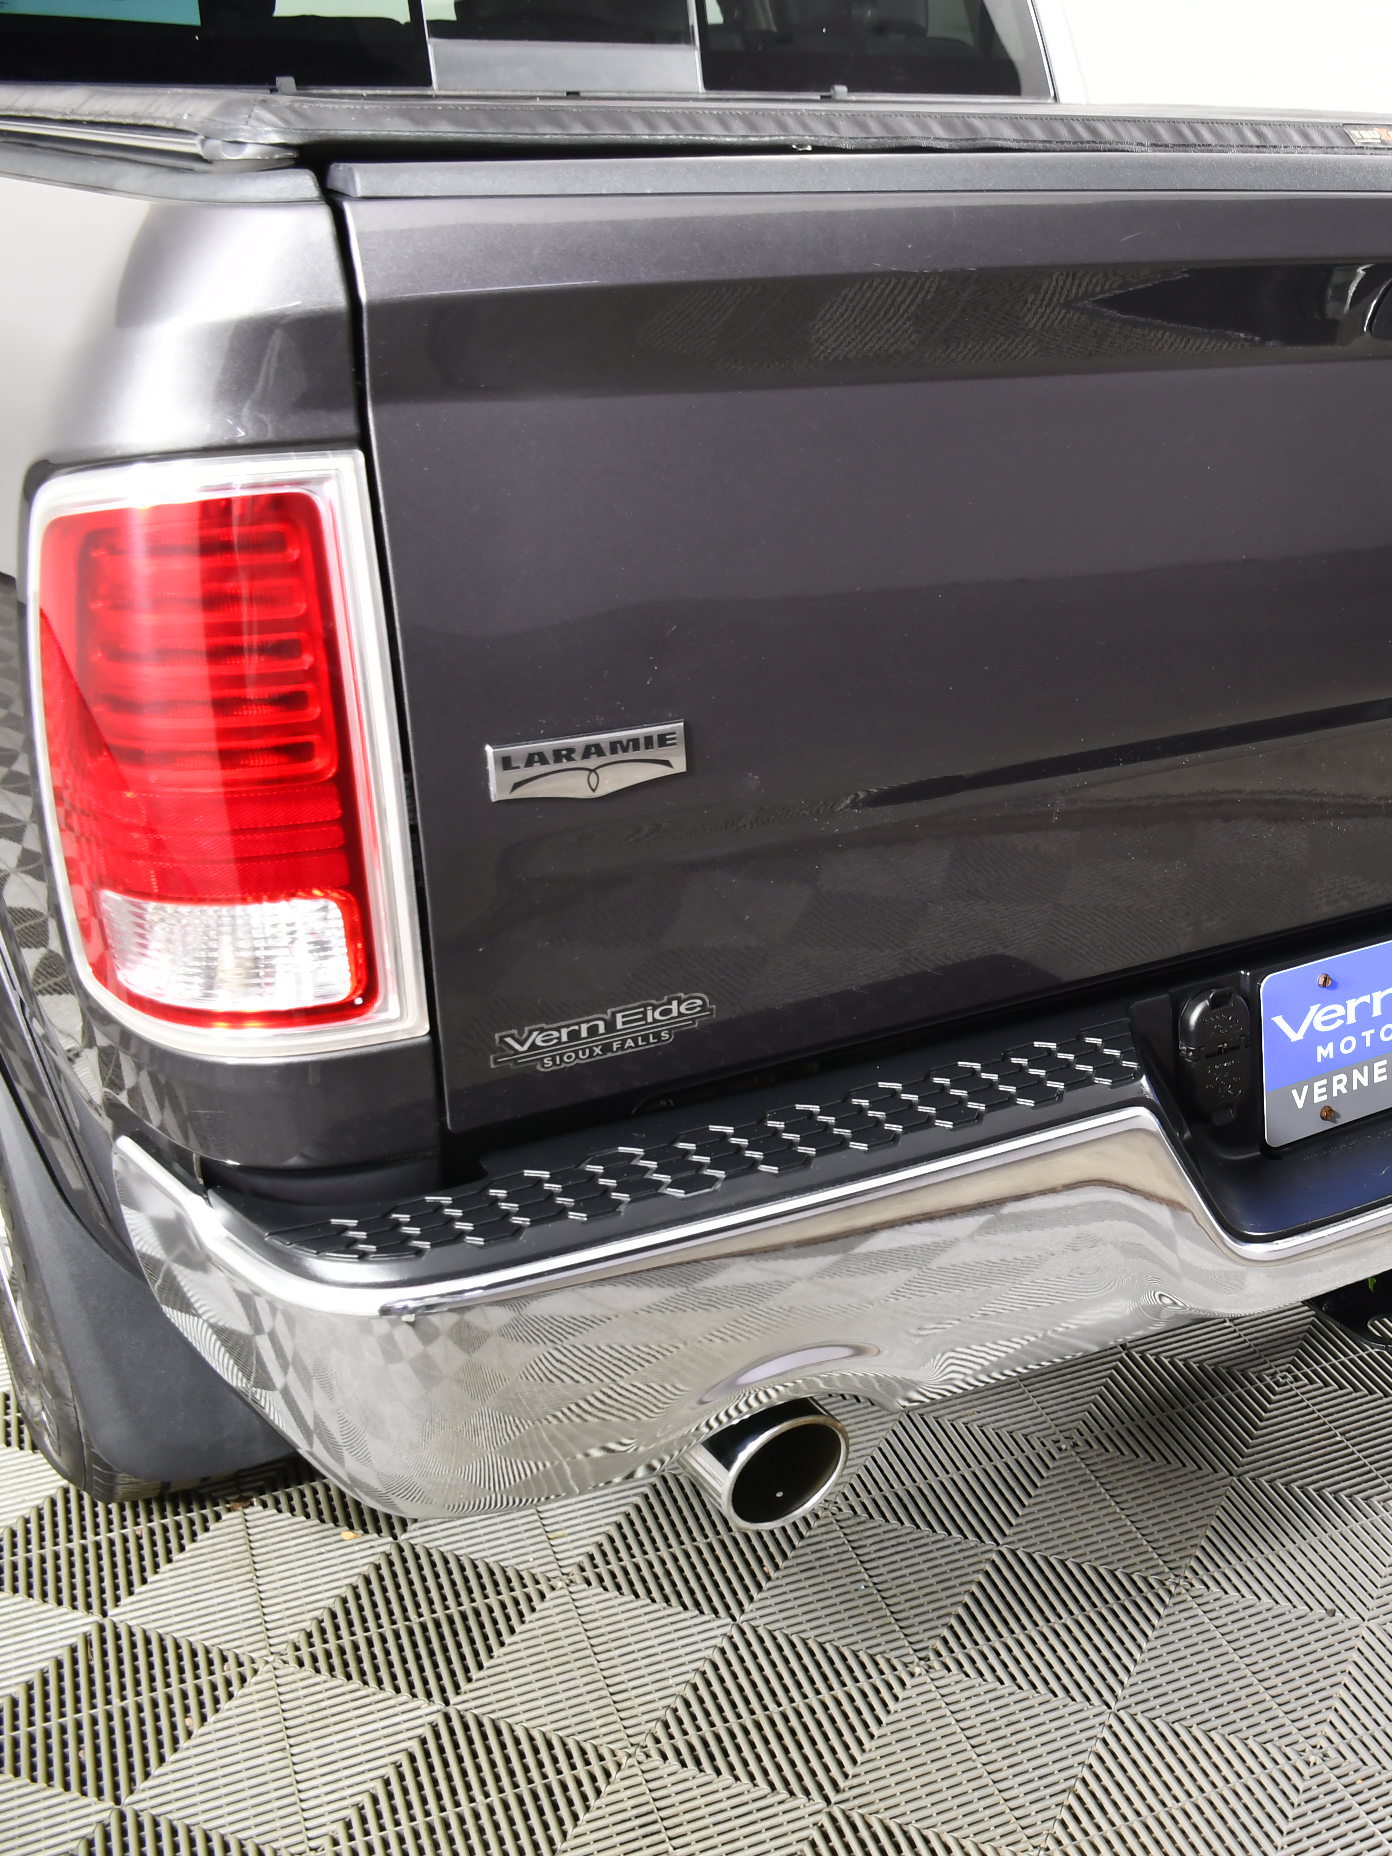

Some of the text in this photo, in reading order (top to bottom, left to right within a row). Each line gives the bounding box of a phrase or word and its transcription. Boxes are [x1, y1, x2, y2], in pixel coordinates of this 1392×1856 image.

[502, 732, 677, 771] LARAMIE
[504, 998, 703, 1052] Vern Eide
[543, 1030, 671, 1068] SIOUX FALLS
